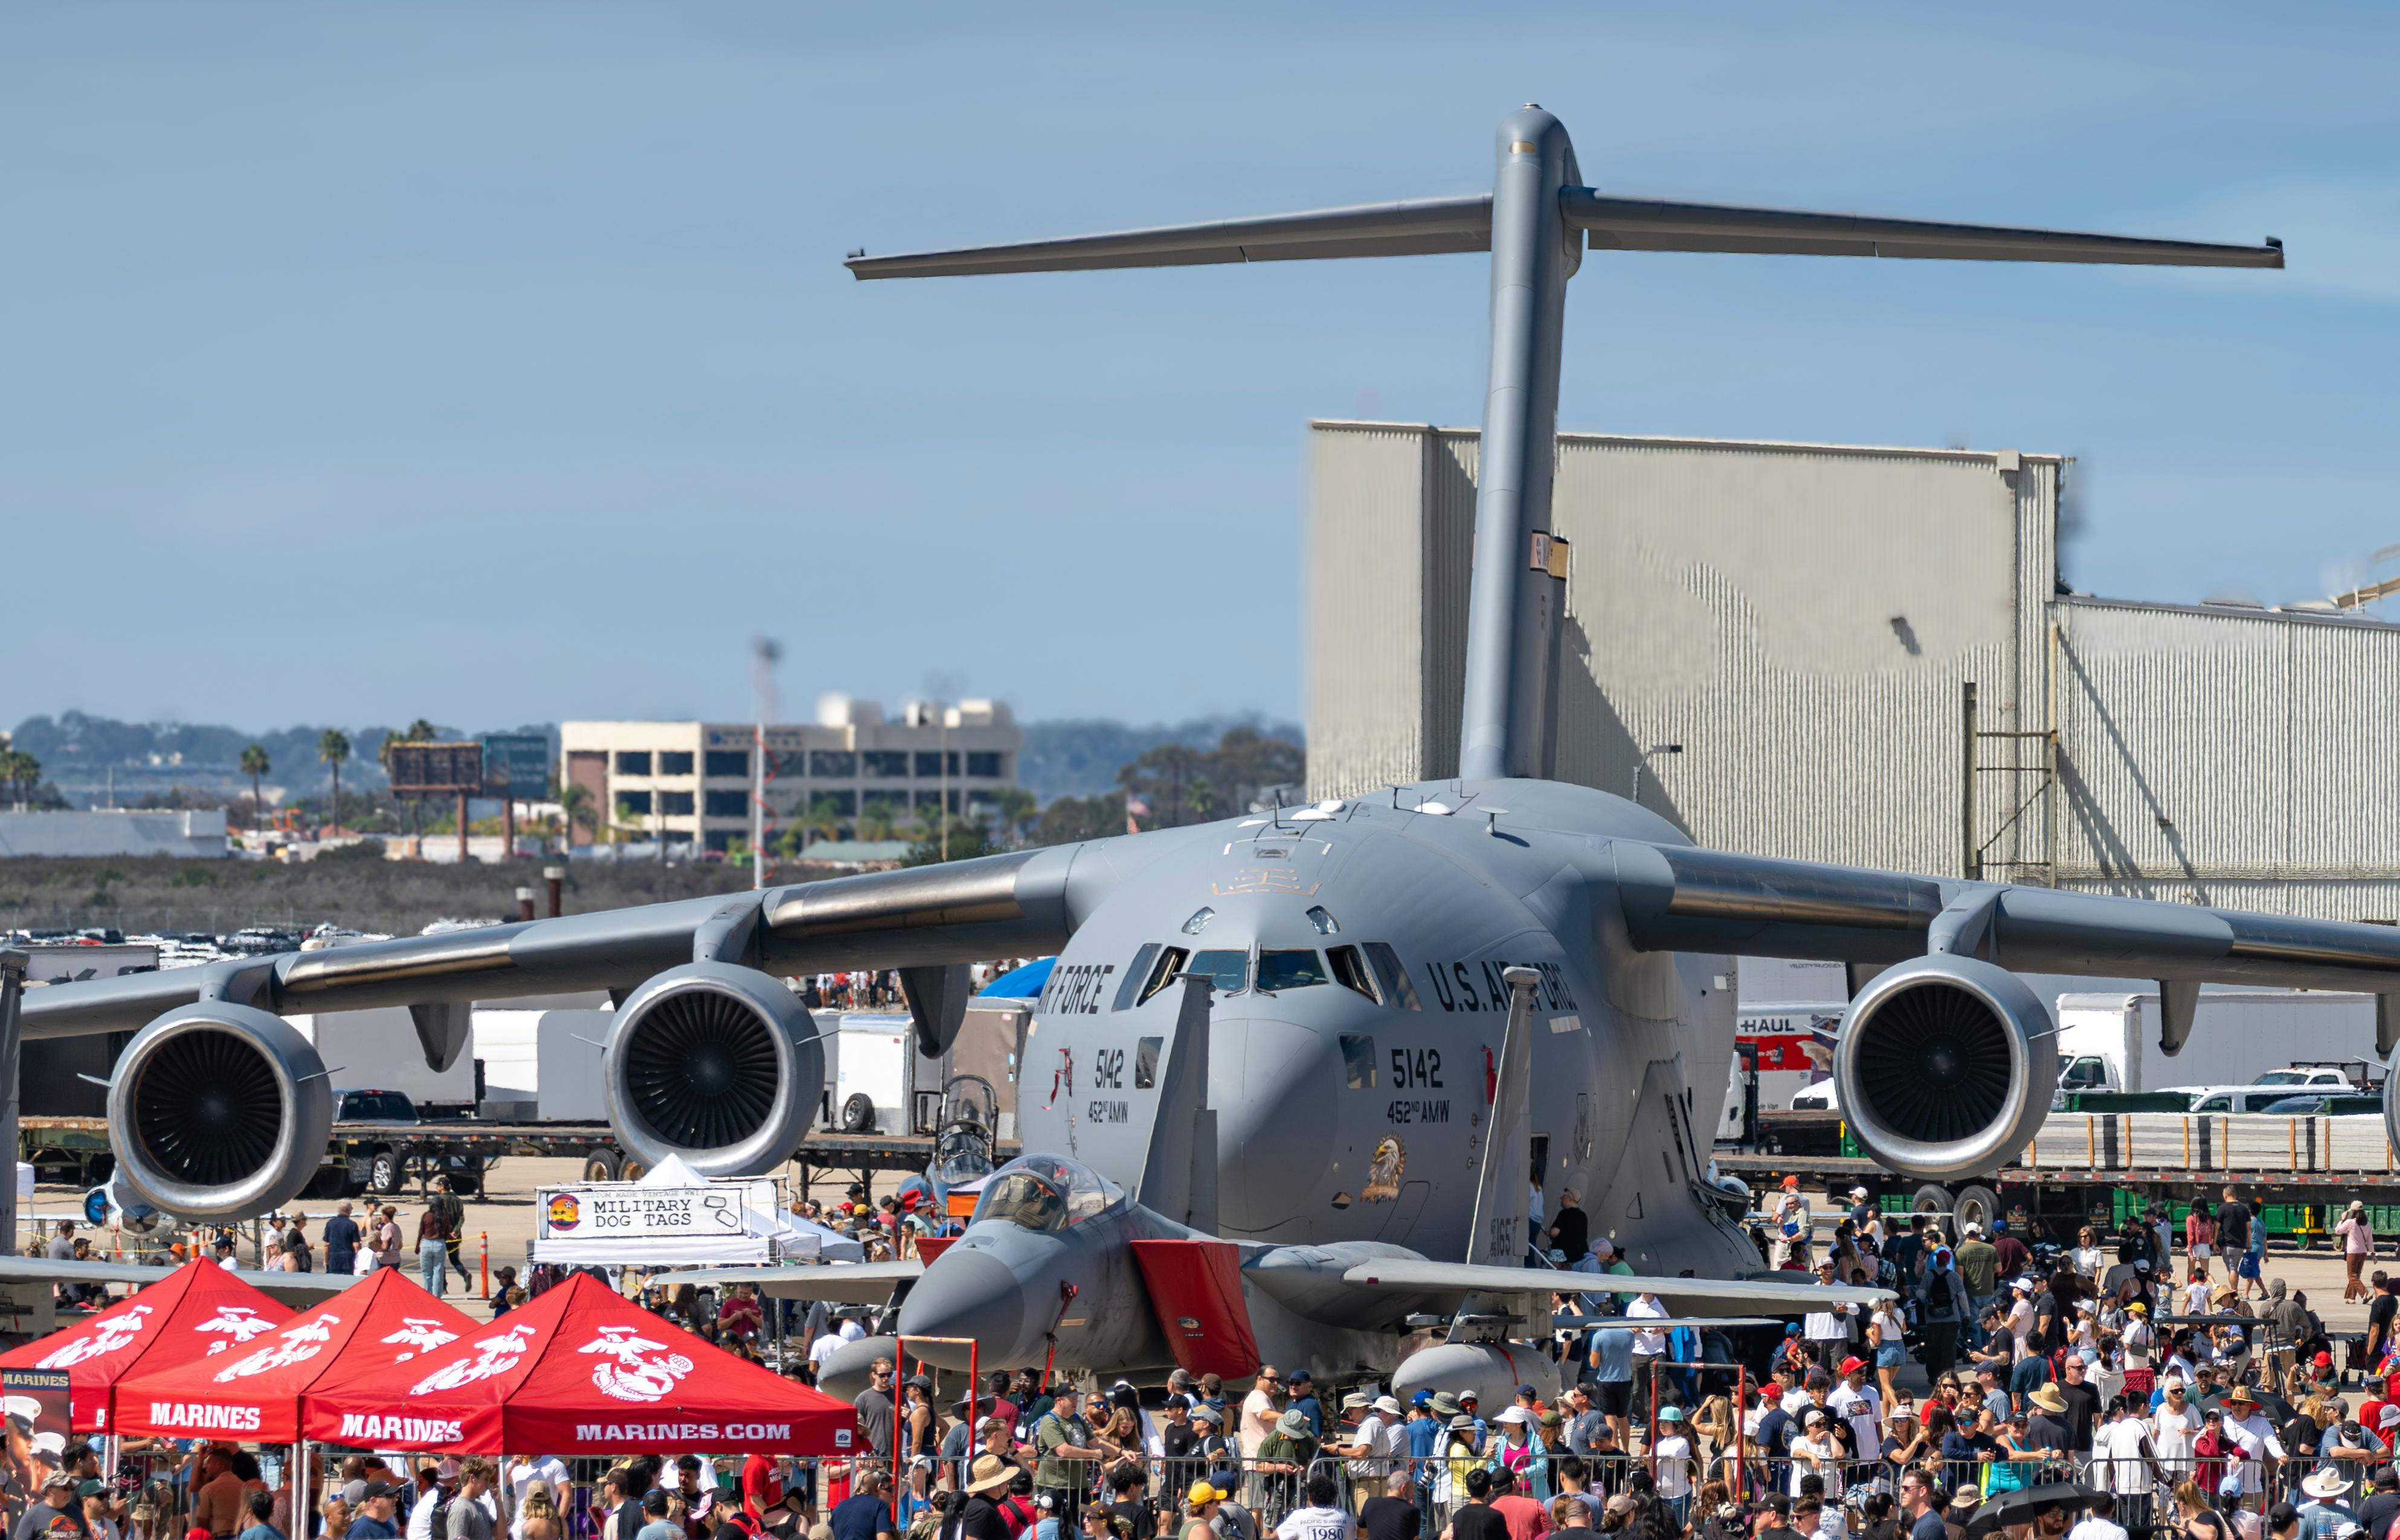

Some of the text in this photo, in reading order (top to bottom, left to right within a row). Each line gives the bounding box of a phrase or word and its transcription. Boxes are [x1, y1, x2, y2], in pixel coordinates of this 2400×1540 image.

[1052, 964, 1115, 1015] FORCE
[1426, 961, 1488, 1012] U.S.
[1736, 1018, 1795, 1033] -HAUL
[1095, 1049, 1124, 1089] 5142
[1391, 1048, 1444, 1088] 5142
[1108, 1100, 1128, 1124] AMW
[1421, 1099, 1450, 1123] AMW
[594, 1199, 692, 1213] MILITARY
[595, 1213, 692, 1228] DOG TAGS
[3, 1373, 69, 1387] MARINES
[150, 1402, 261, 1431] MARINES
[339, 1414, 464, 1443] MARINES
[576, 1423, 791, 1441] MARINES.COM
[1311, 1528, 1344, 1540] 1980
